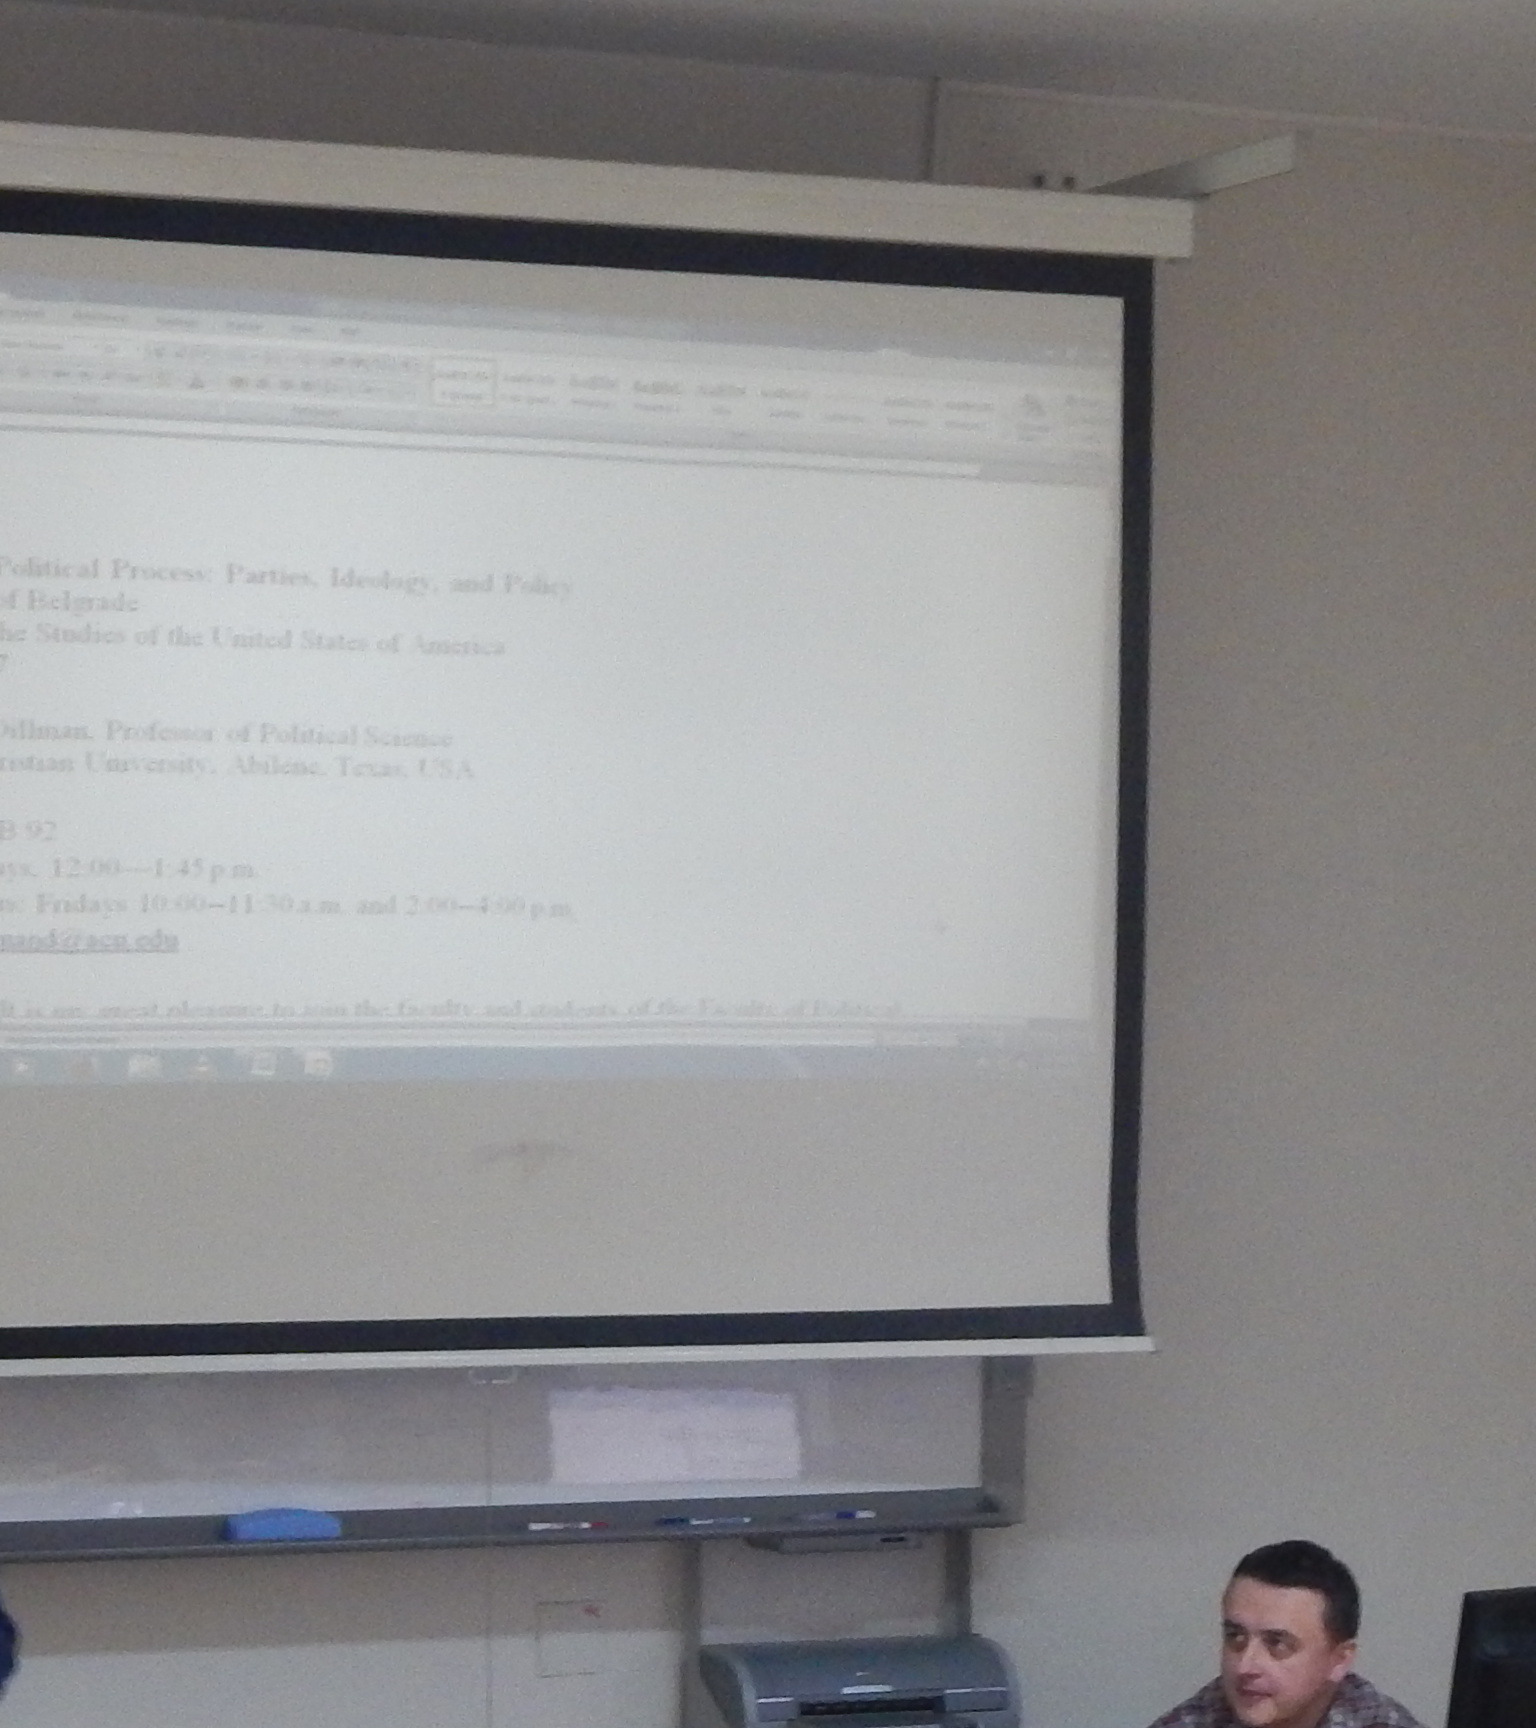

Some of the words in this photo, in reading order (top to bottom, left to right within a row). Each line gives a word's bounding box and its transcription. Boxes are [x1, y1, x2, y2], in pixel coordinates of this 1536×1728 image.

[133, 623, 159, 647] of
[166, 624, 204, 648] the
[375, 631, 403, 654] of
[225, 720, 255, 745] of
